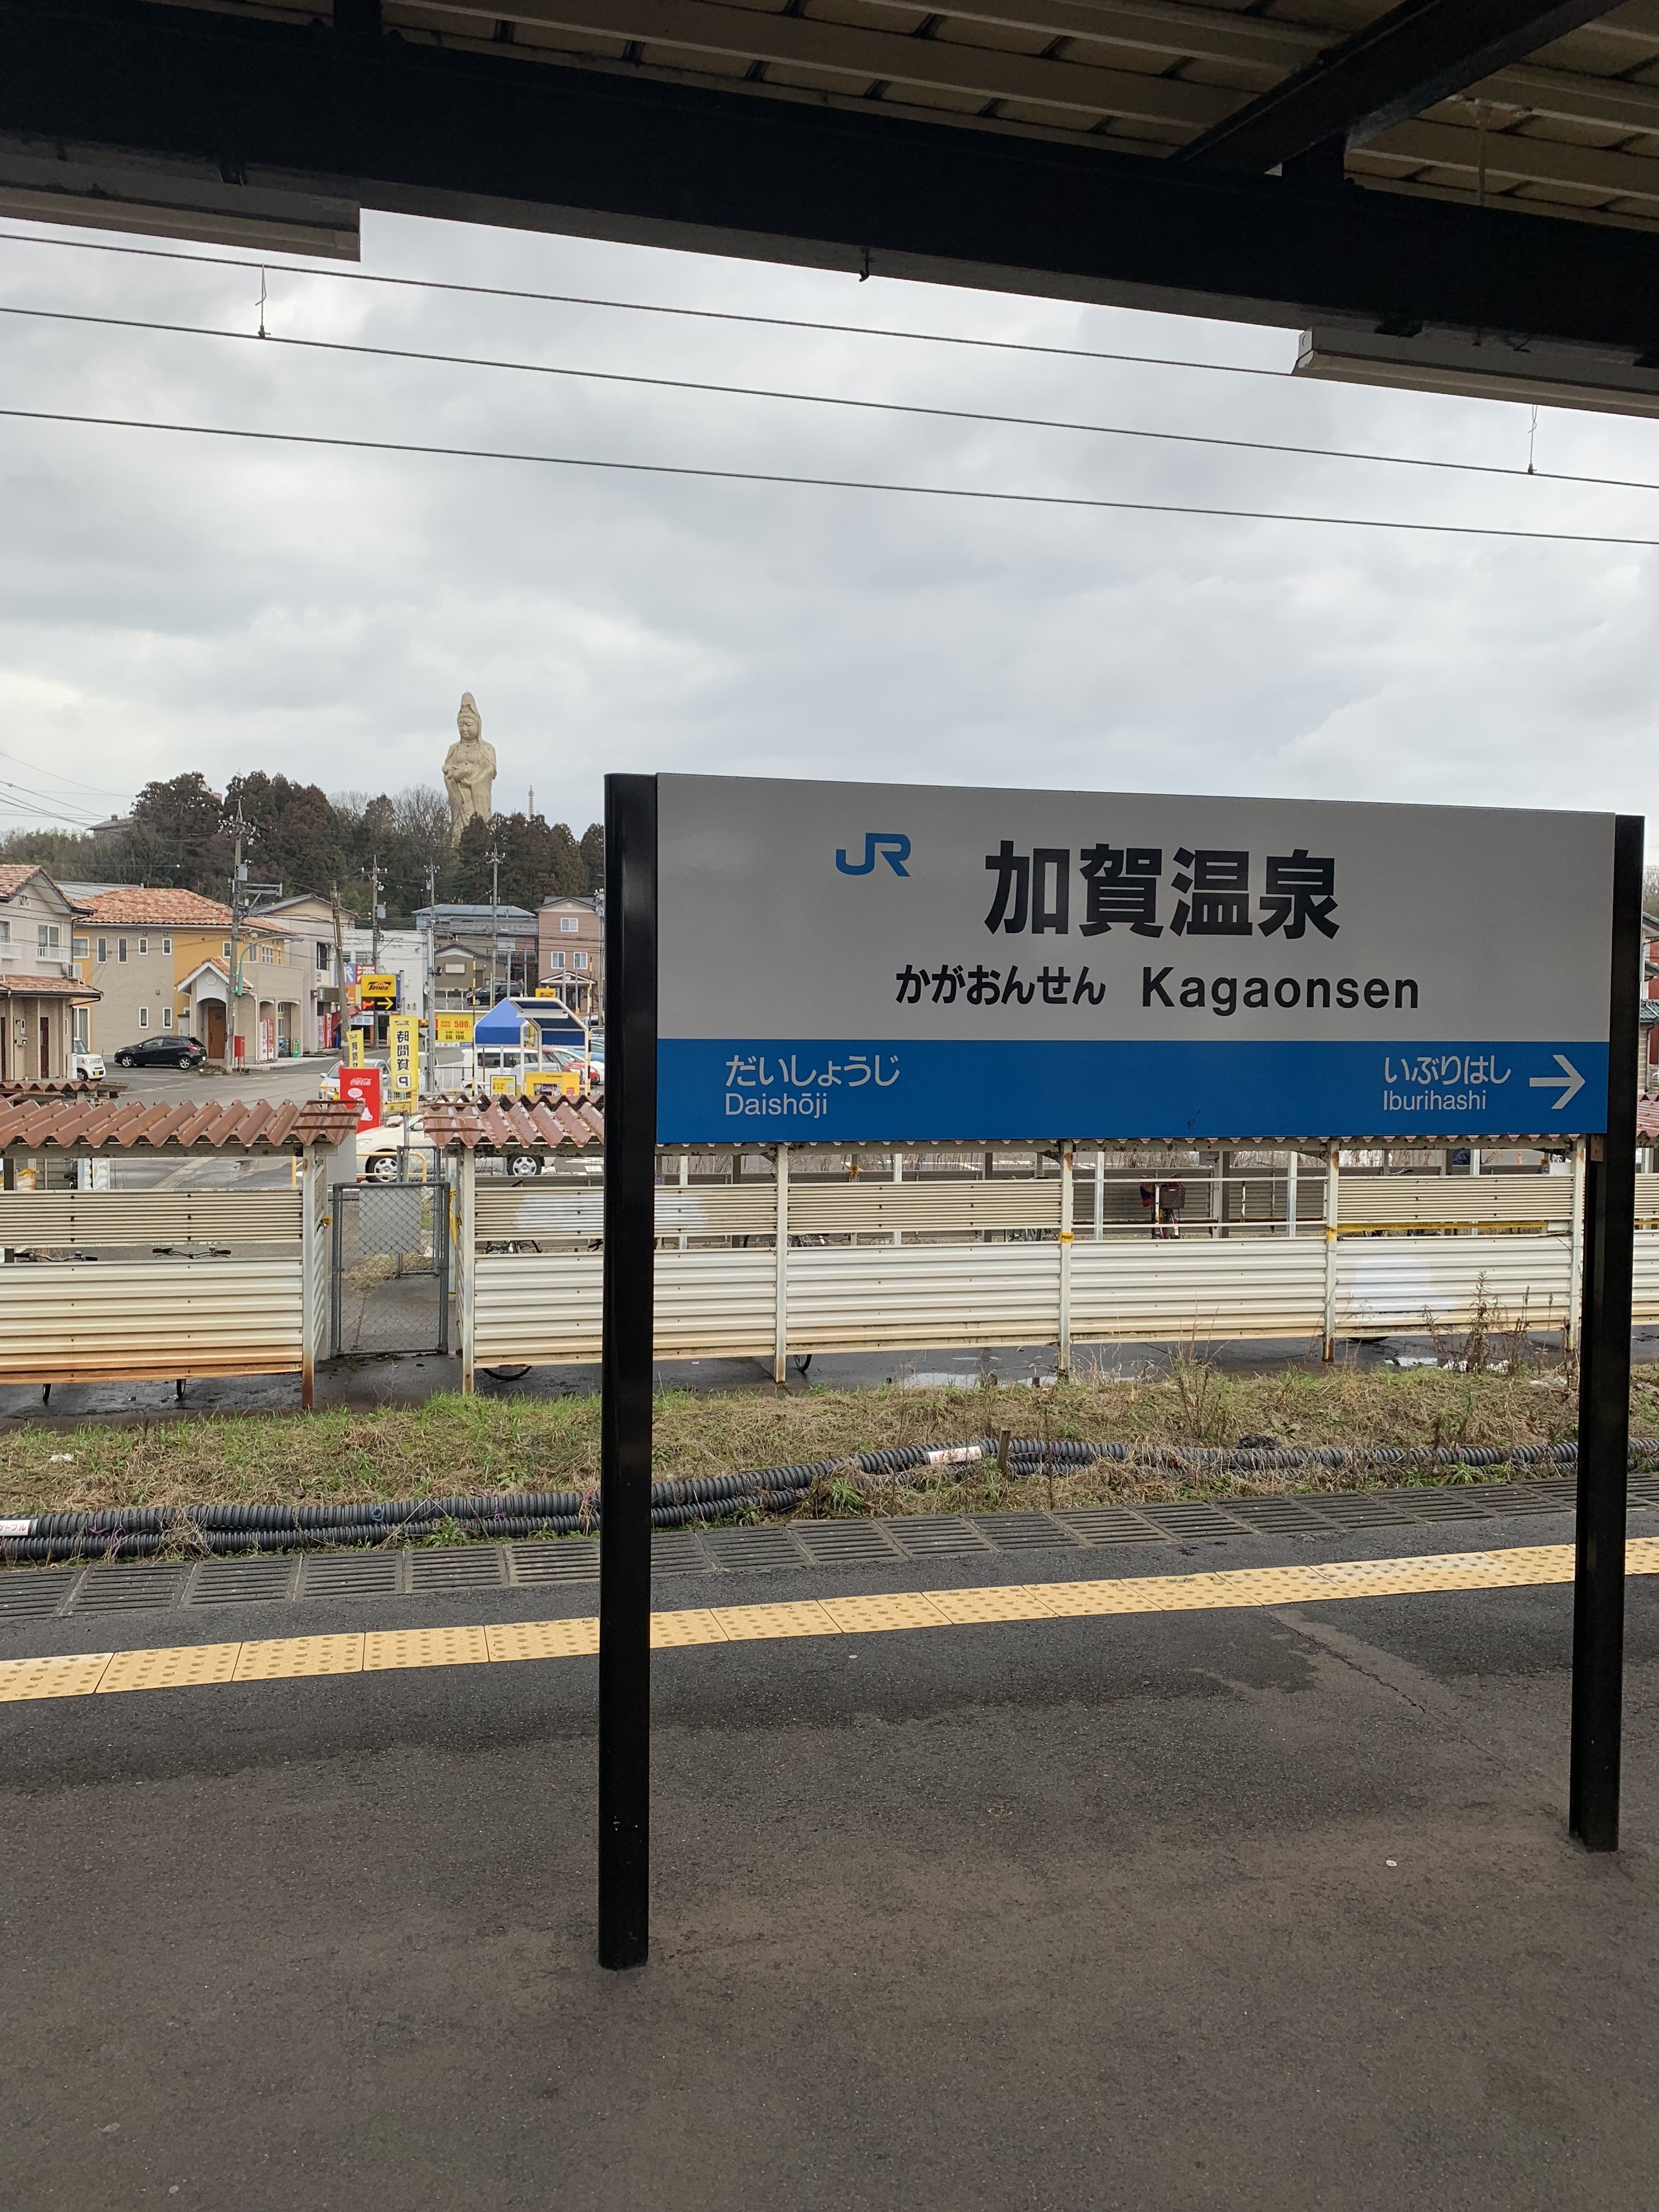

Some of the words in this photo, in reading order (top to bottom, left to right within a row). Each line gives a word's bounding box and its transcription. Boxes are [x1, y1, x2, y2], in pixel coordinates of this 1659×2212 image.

[836, 833, 911, 877] JR
[983, 839, 1341, 940] 加賀温泉
[368, 981, 392, 991] Times
[895, 964, 1107, 1006] かがおんせん
[1142, 966, 1419, 1017] Kagaonsen
[725, 1054, 900, 1087] だいしょうじ
[1384, 1054, 1512, 1086] いぶりはし
[725, 1092, 827, 1119] Daishōji
[1383, 1090, 1486, 1111] Iburihashi
